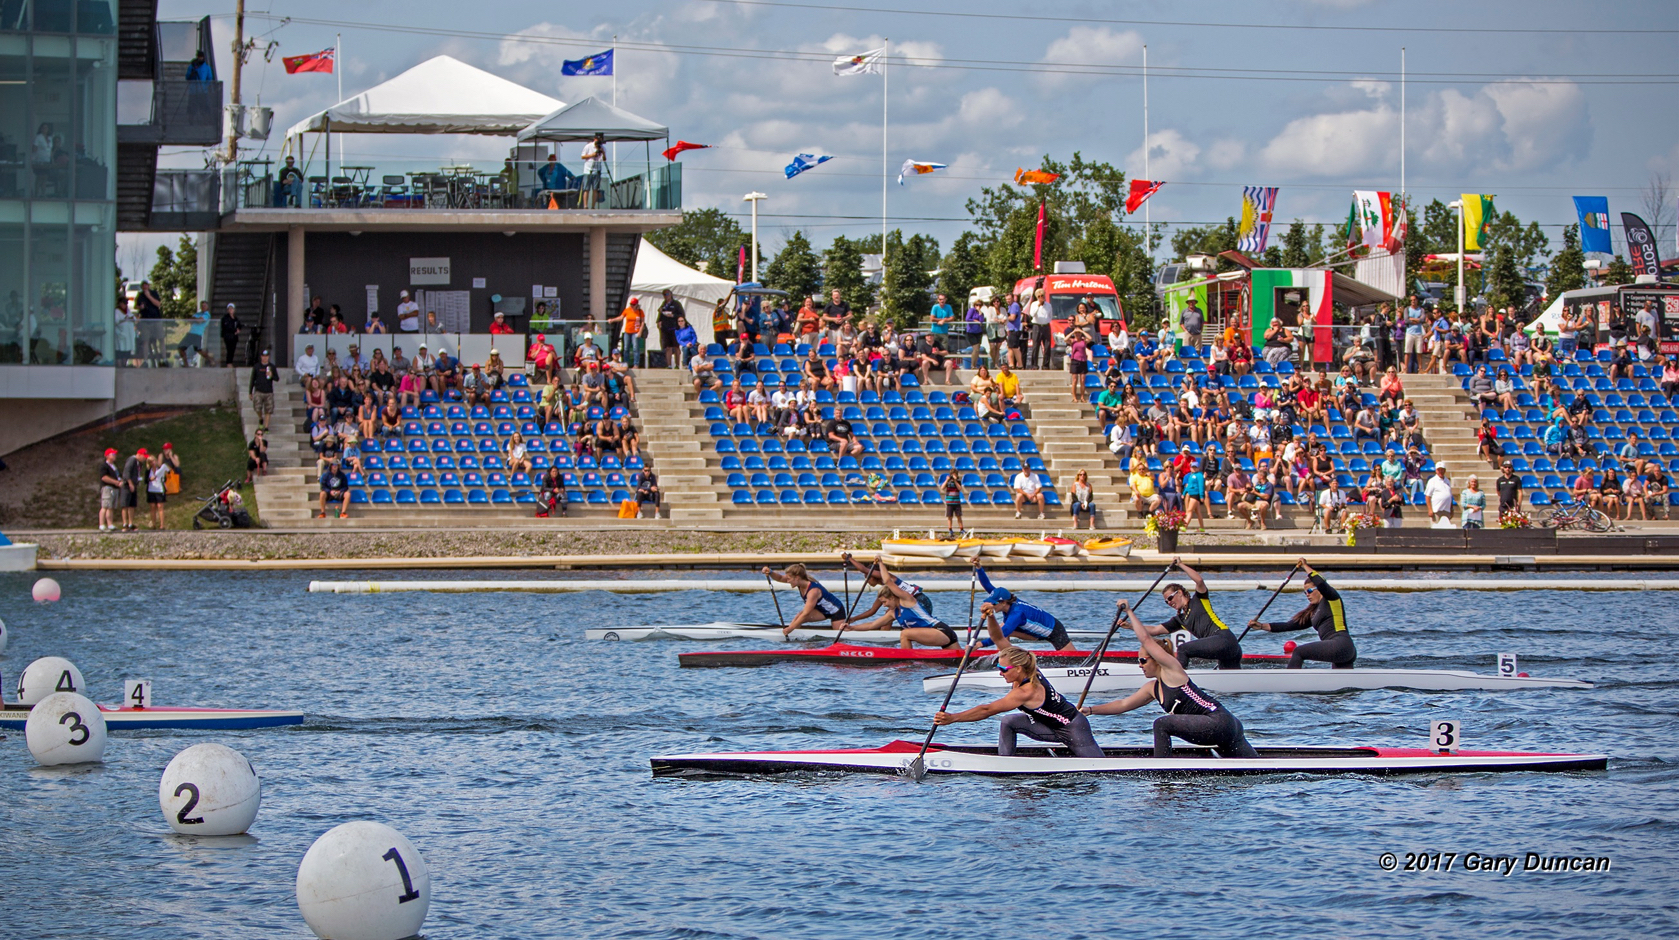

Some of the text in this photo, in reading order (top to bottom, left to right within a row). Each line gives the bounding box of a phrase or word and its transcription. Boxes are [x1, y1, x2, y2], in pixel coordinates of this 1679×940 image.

[410, 266, 449, 275] RESULTS
[1052, 280, 1071, 290] Tim
[1176, 633, 1186, 647] 6
[1500, 658, 1515, 673] 5
[55, 669, 77, 692] 4
[131, 683, 145, 704] 4
[59, 711, 90, 746] 3
[1436, 722, 1454, 746] 3
[902, 758, 952, 768] NLO
[173, 782, 204, 824] 2
[382, 847, 420, 904] 1
